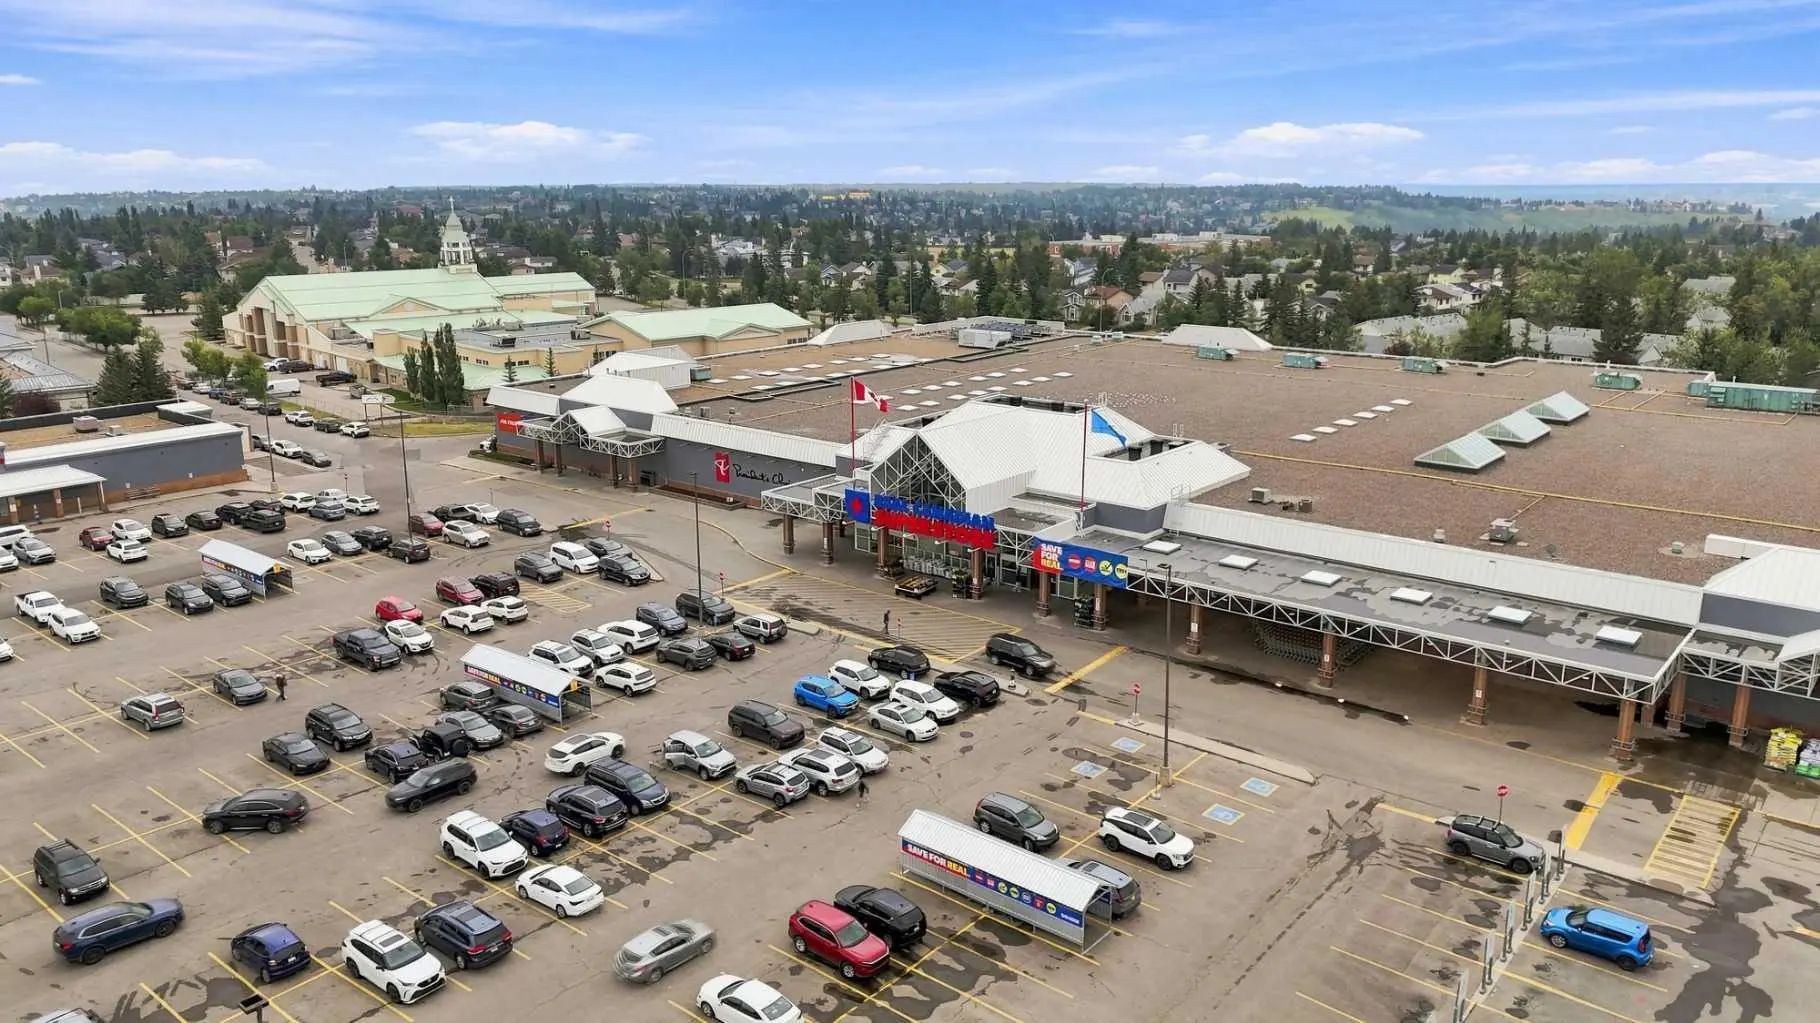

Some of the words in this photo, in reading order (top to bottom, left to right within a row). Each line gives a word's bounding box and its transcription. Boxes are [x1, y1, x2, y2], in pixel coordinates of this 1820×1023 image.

[1040, 543, 1063, 556] SAVE
[1041, 551, 1058, 561] FOR
[907, 843, 929, 860] SAVE
[928, 852, 946, 867] FOR
[946, 860, 967, 876] REAL
